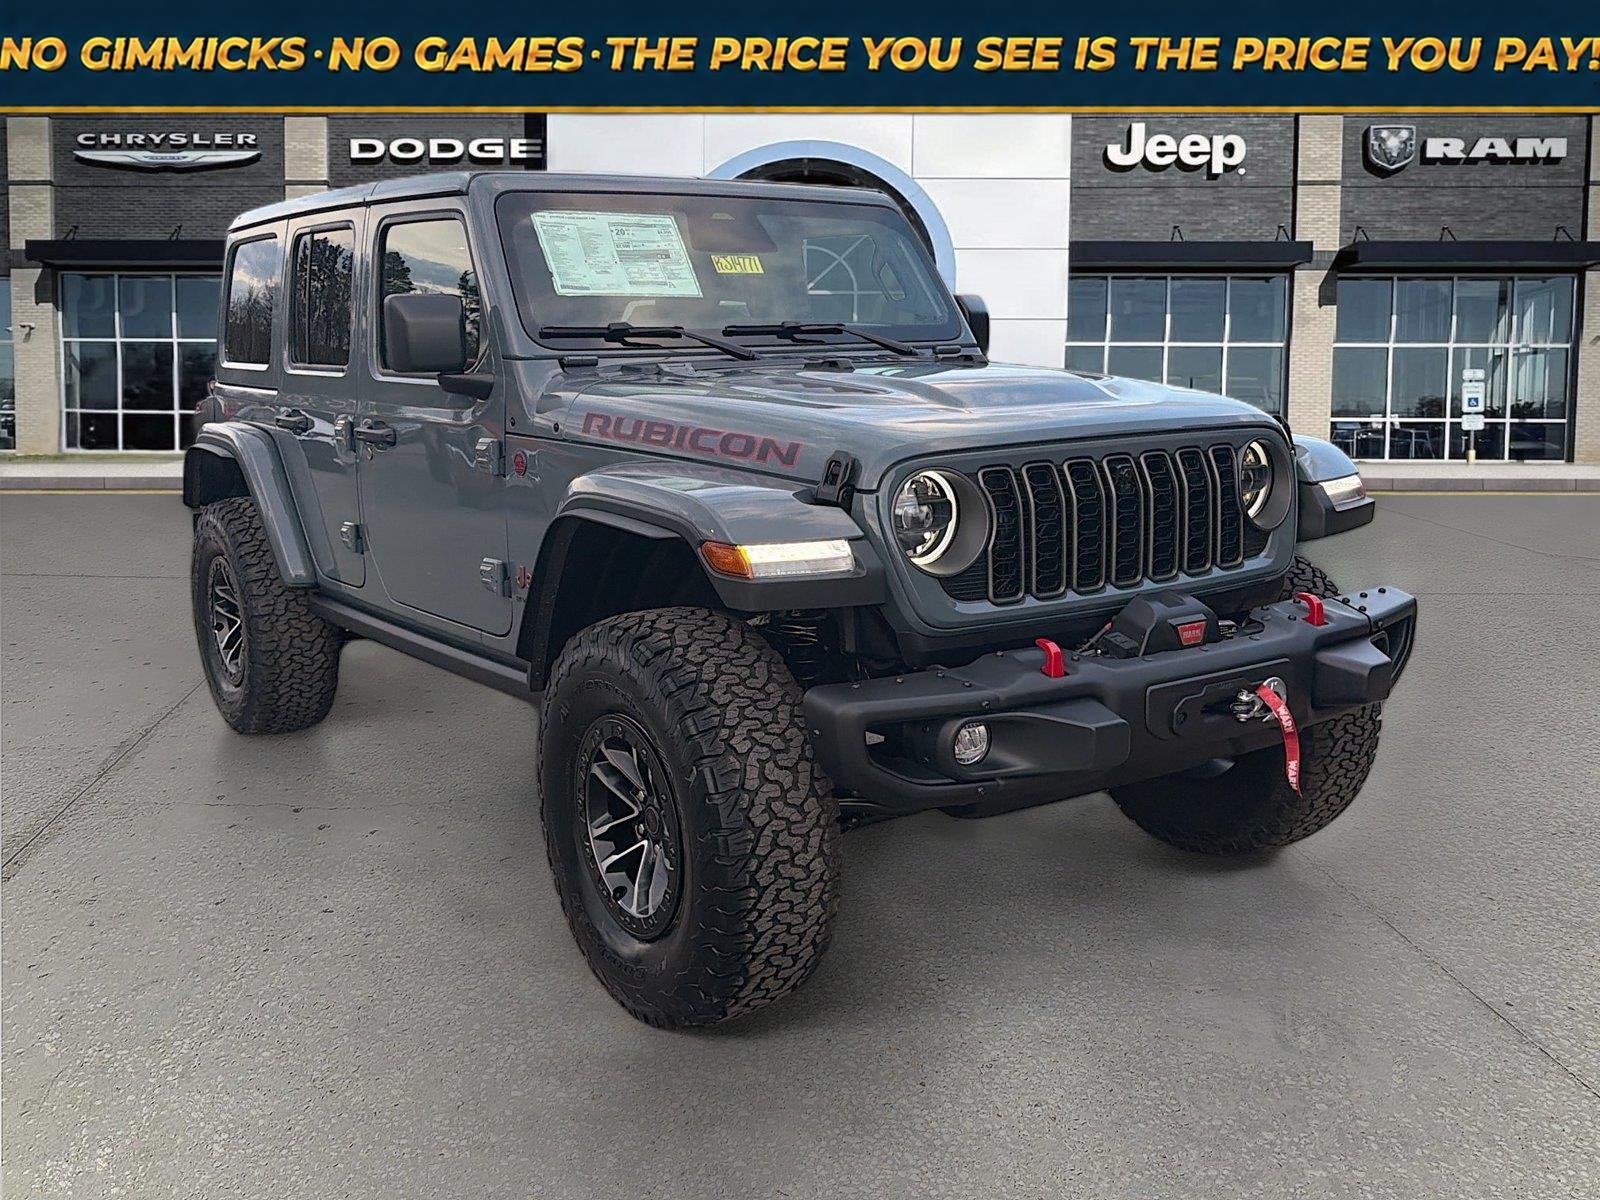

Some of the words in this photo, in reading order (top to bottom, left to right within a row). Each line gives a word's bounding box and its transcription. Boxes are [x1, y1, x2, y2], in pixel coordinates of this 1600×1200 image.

[76, 132, 258, 146] CHRYSLER
[350, 138, 543, 159] DODGE
[1106, 122, 1247, 175] Jeep
[1424, 137, 1569, 159] RAM
[581, 412, 804, 468] RUBICON
[1276, 704, 1294, 734] WARN
